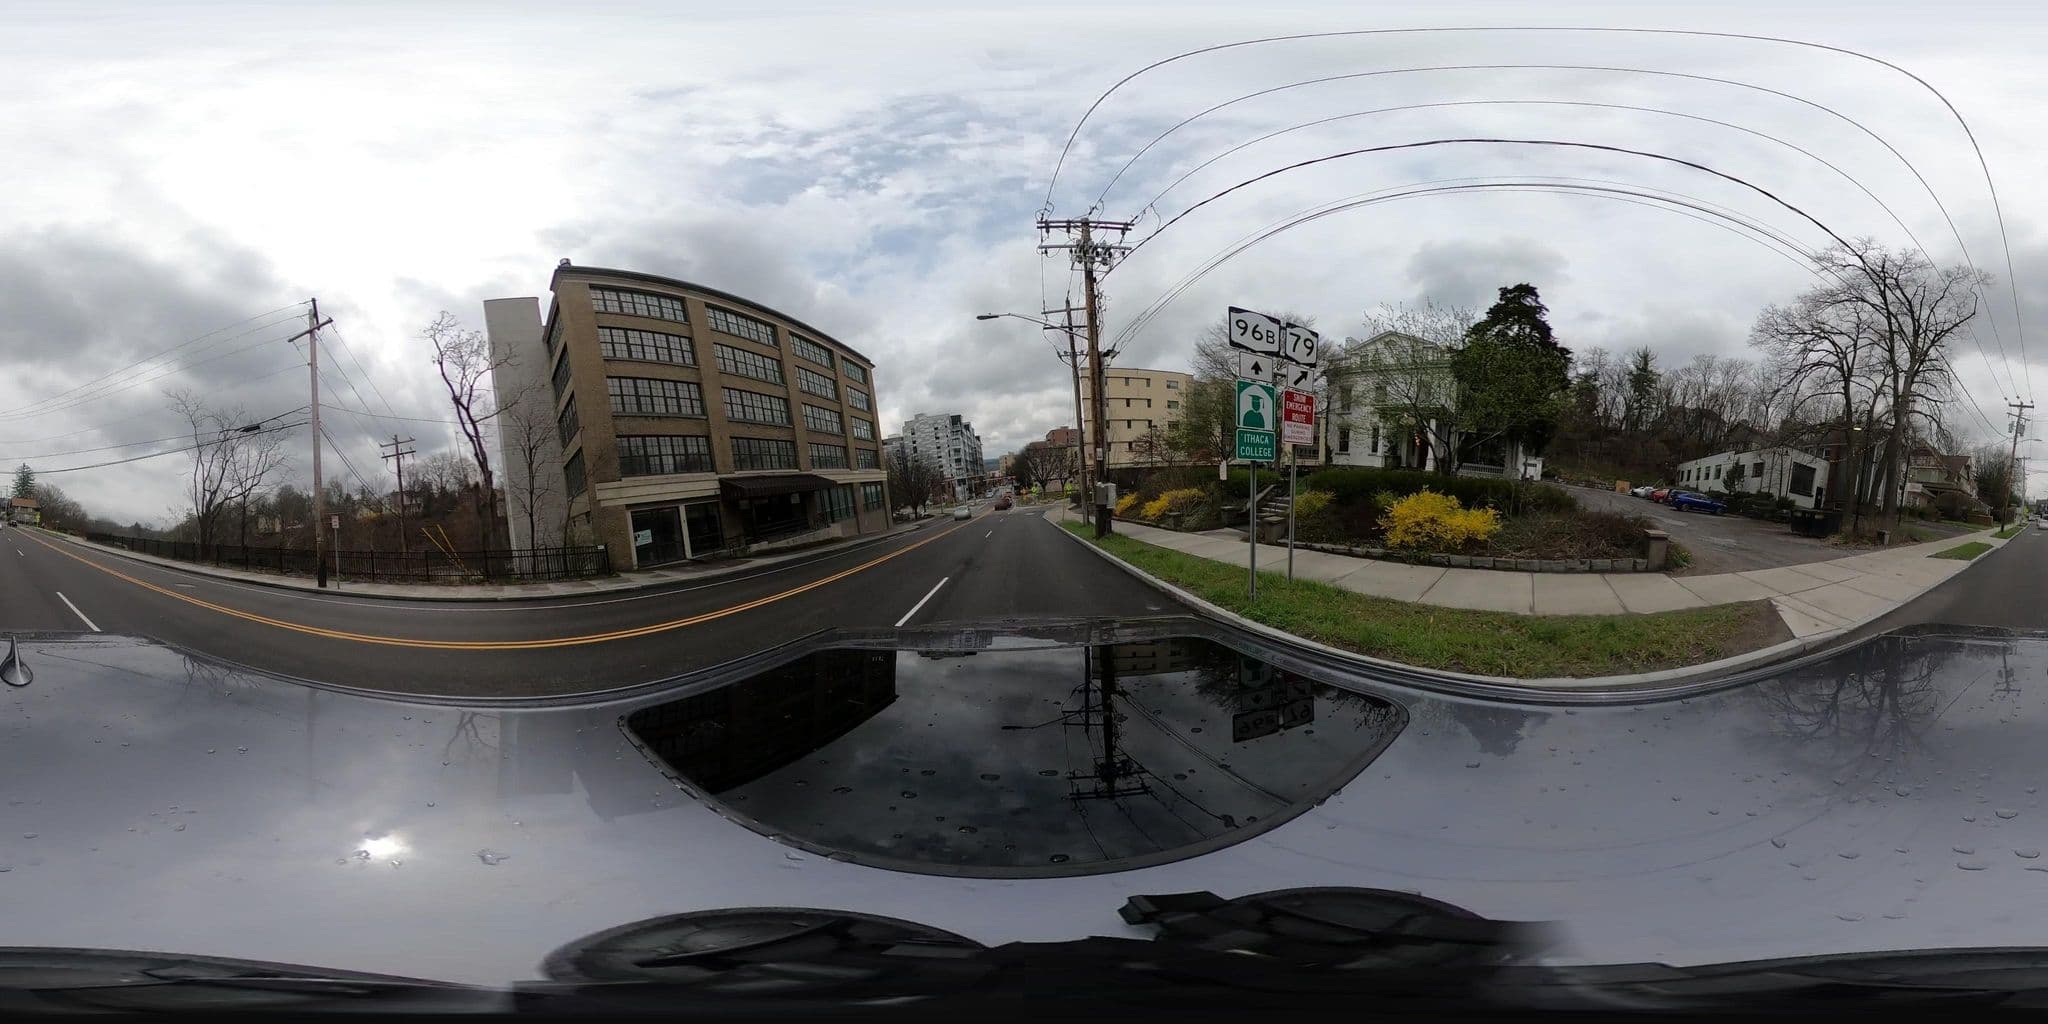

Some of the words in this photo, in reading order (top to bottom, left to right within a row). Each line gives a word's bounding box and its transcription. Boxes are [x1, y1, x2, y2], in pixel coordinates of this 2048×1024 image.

[1235, 318, 1276, 345] 96B
[1289, 332, 1315, 357] 79
[1286, 401, 1312, 413] EMERGENCY
[1291, 412, 1306, 423] ROUTE
[1243, 433, 1269, 445] ITHACA
[1240, 446, 1272, 457] COLLEGE
